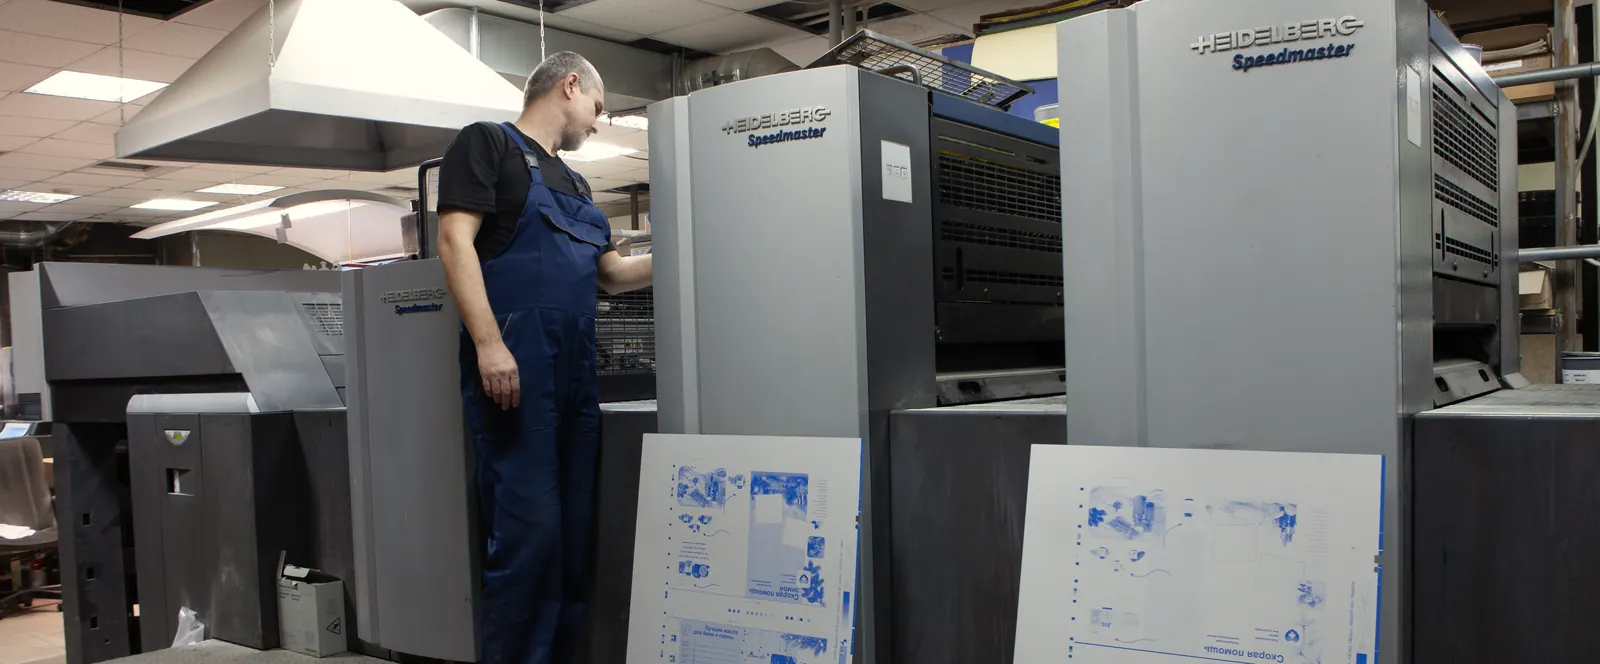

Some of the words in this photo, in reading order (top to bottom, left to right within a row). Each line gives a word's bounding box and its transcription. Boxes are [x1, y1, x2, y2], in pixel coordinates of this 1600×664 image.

[1190, 15, 1364, 54] HEIDELBERG
[1232, 43, 1355, 72] Speedmaster
[722, 105, 832, 135] HEIDELBERG
[747, 127, 827, 149] Speedmaster
[380, 288, 446, 304] HEIDELBERG
[1204, 645, 1244, 657] помощь
[1247, 650, 1284, 664] Скорая
